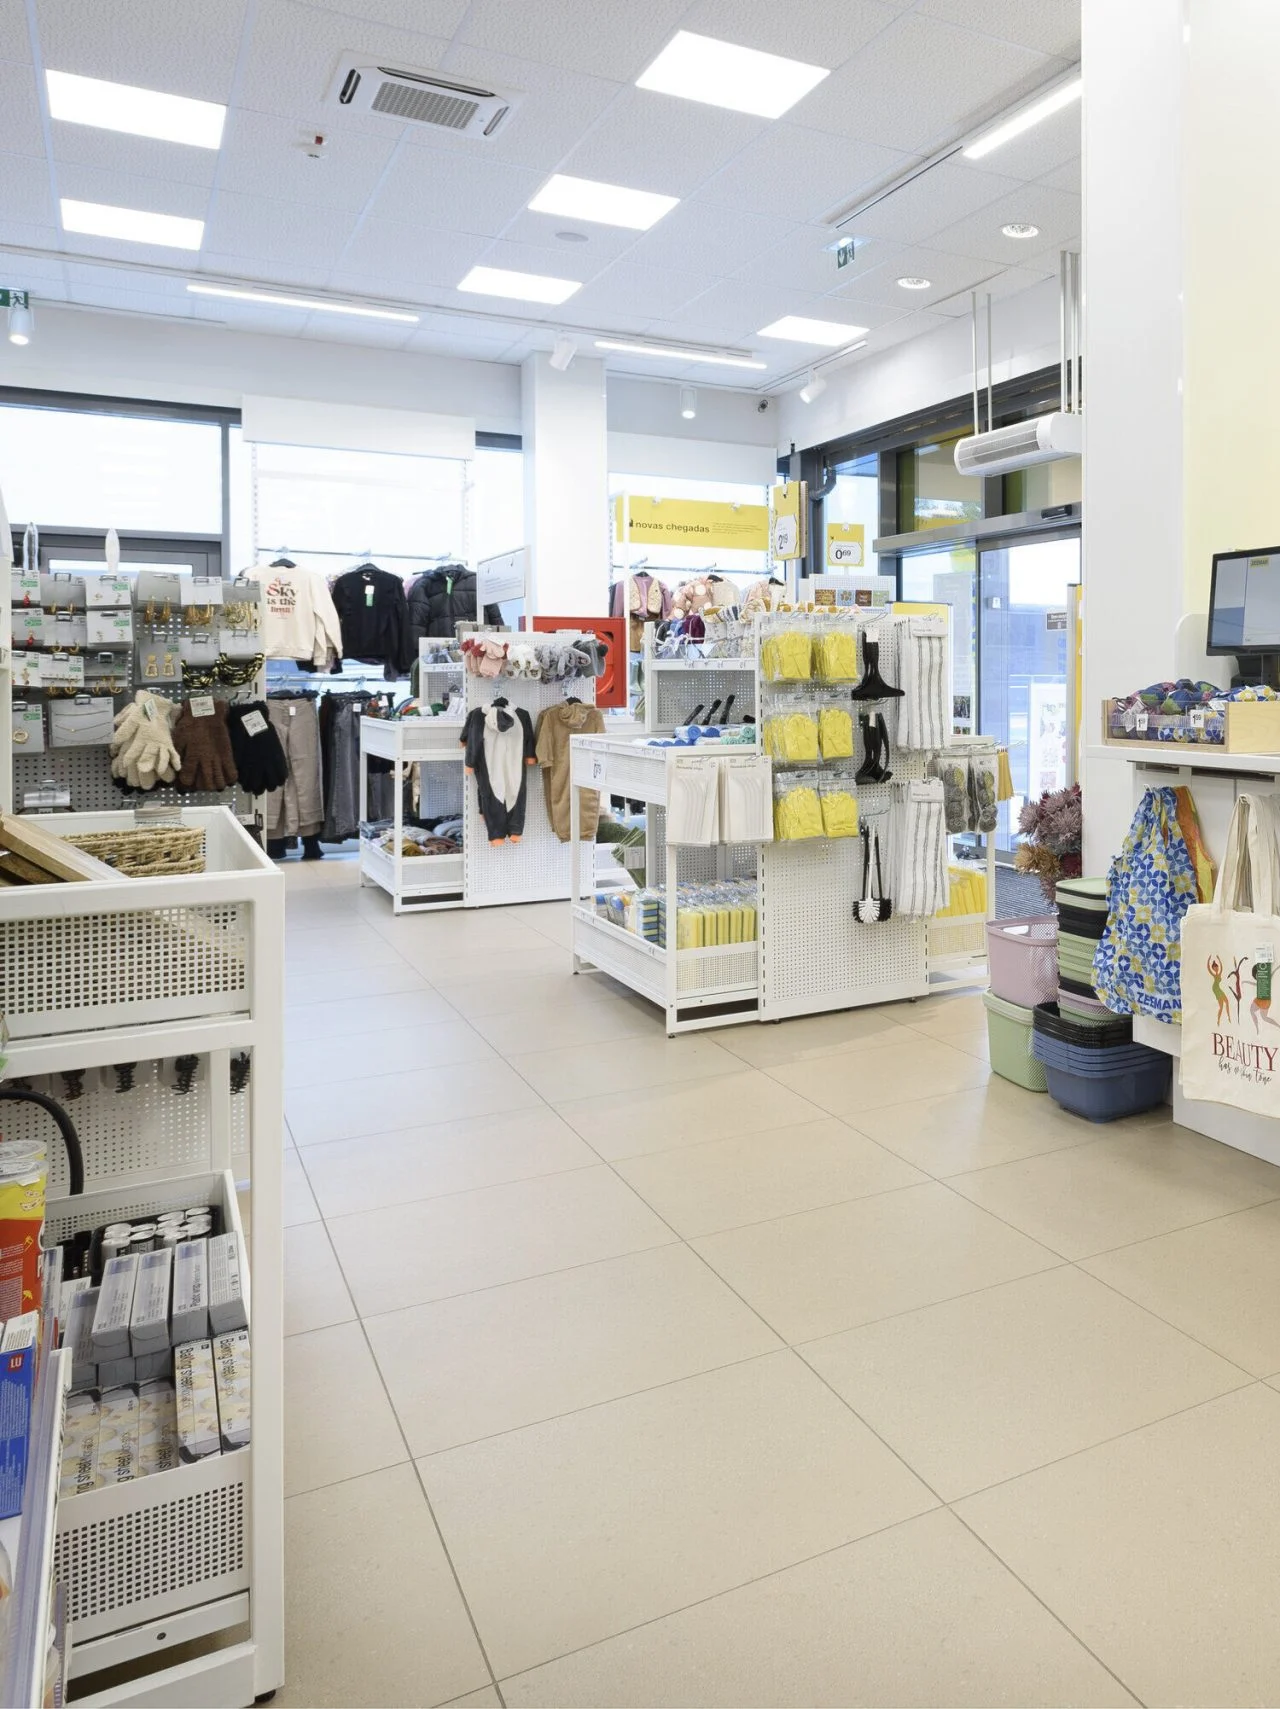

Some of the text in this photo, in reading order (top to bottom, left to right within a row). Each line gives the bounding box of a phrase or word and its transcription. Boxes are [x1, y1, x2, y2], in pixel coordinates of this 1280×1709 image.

[635, 522, 663, 531] novas
[666, 523, 710, 534] chegadas
[1136, 992, 1182, 1010] ZEEMAN
[1211, 1032, 1279, 1071] BEAUTY
[10, 1357, 22, 1369] LU
